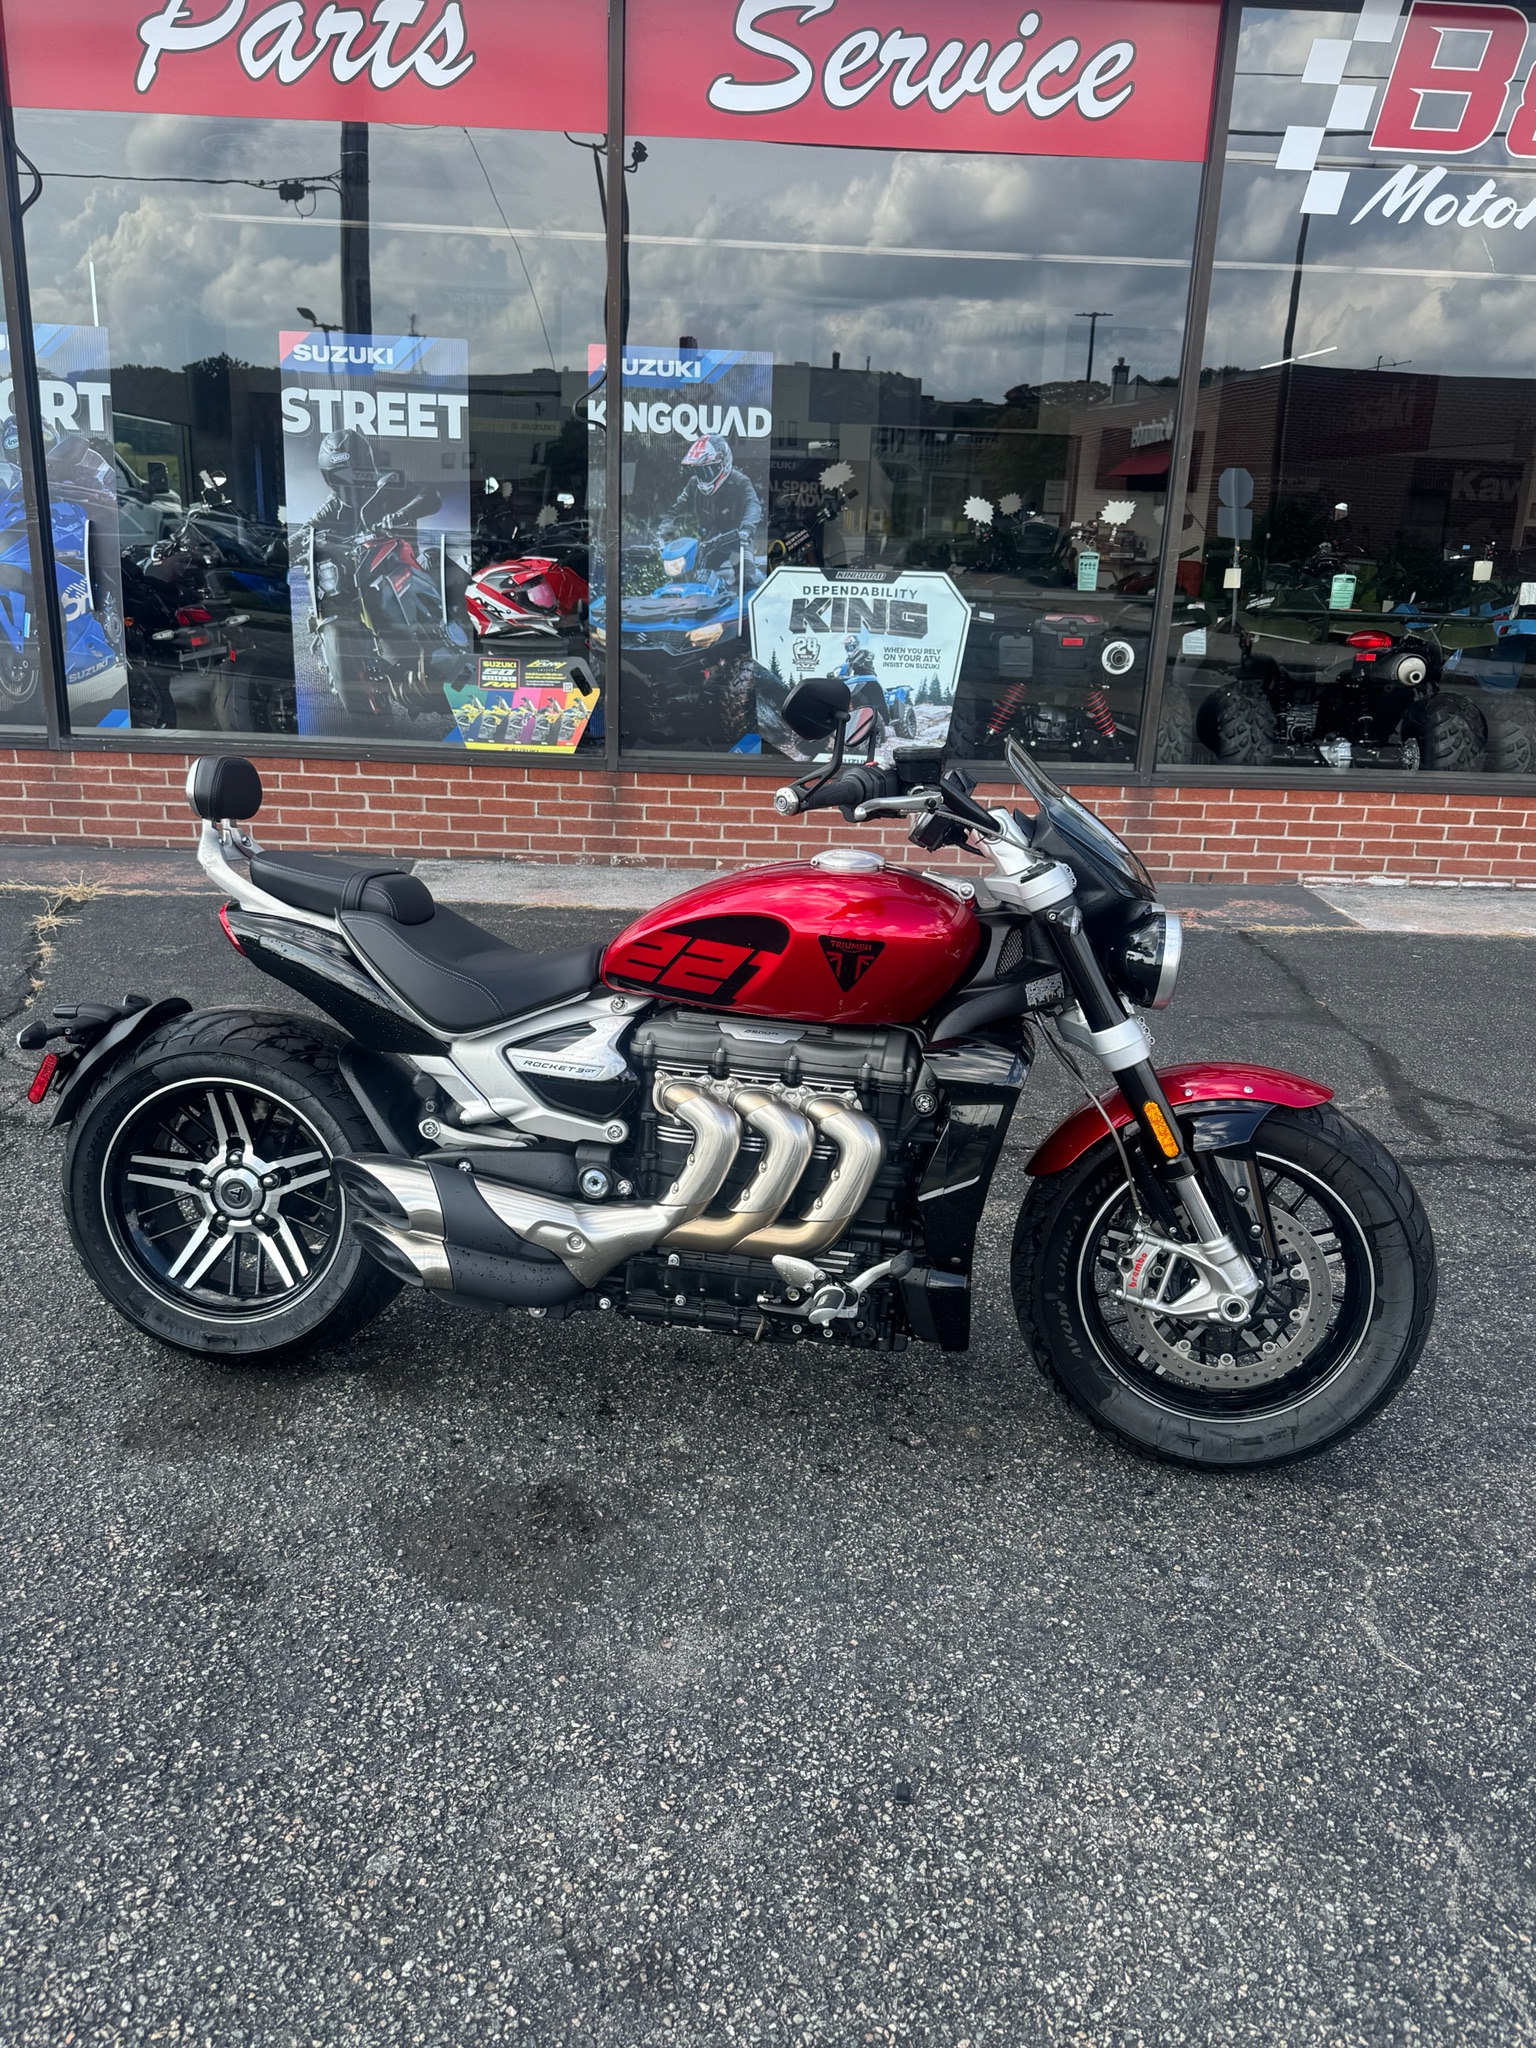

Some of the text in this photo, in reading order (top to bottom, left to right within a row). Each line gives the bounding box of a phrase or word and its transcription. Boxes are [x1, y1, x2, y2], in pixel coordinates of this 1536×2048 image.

[136, 0, 474, 93] Parts
[708, 0, 1136, 120] Service
[293, 344, 394, 364] SUZUKI
[602, 357, 701, 378] UZUKI
[281, 387, 469, 439] STREET
[588, 400, 772, 441] KNGQUAD
[802, 585, 919, 600] DEPENDABILITY
[788, 597, 929, 639] KING
[482, 660, 517, 668] SUZUKI
[883, 653, 897, 661] ON
[898, 654, 922, 663] YOUR
[884, 646, 941, 656] WHEN YOU RELY
[69, 657, 108, 683] SUZUKI
[830, 939, 872, 952] TRIUMPH
[606, 931, 778, 1001] 221
[1128, 1252, 1148, 1289] brembo
